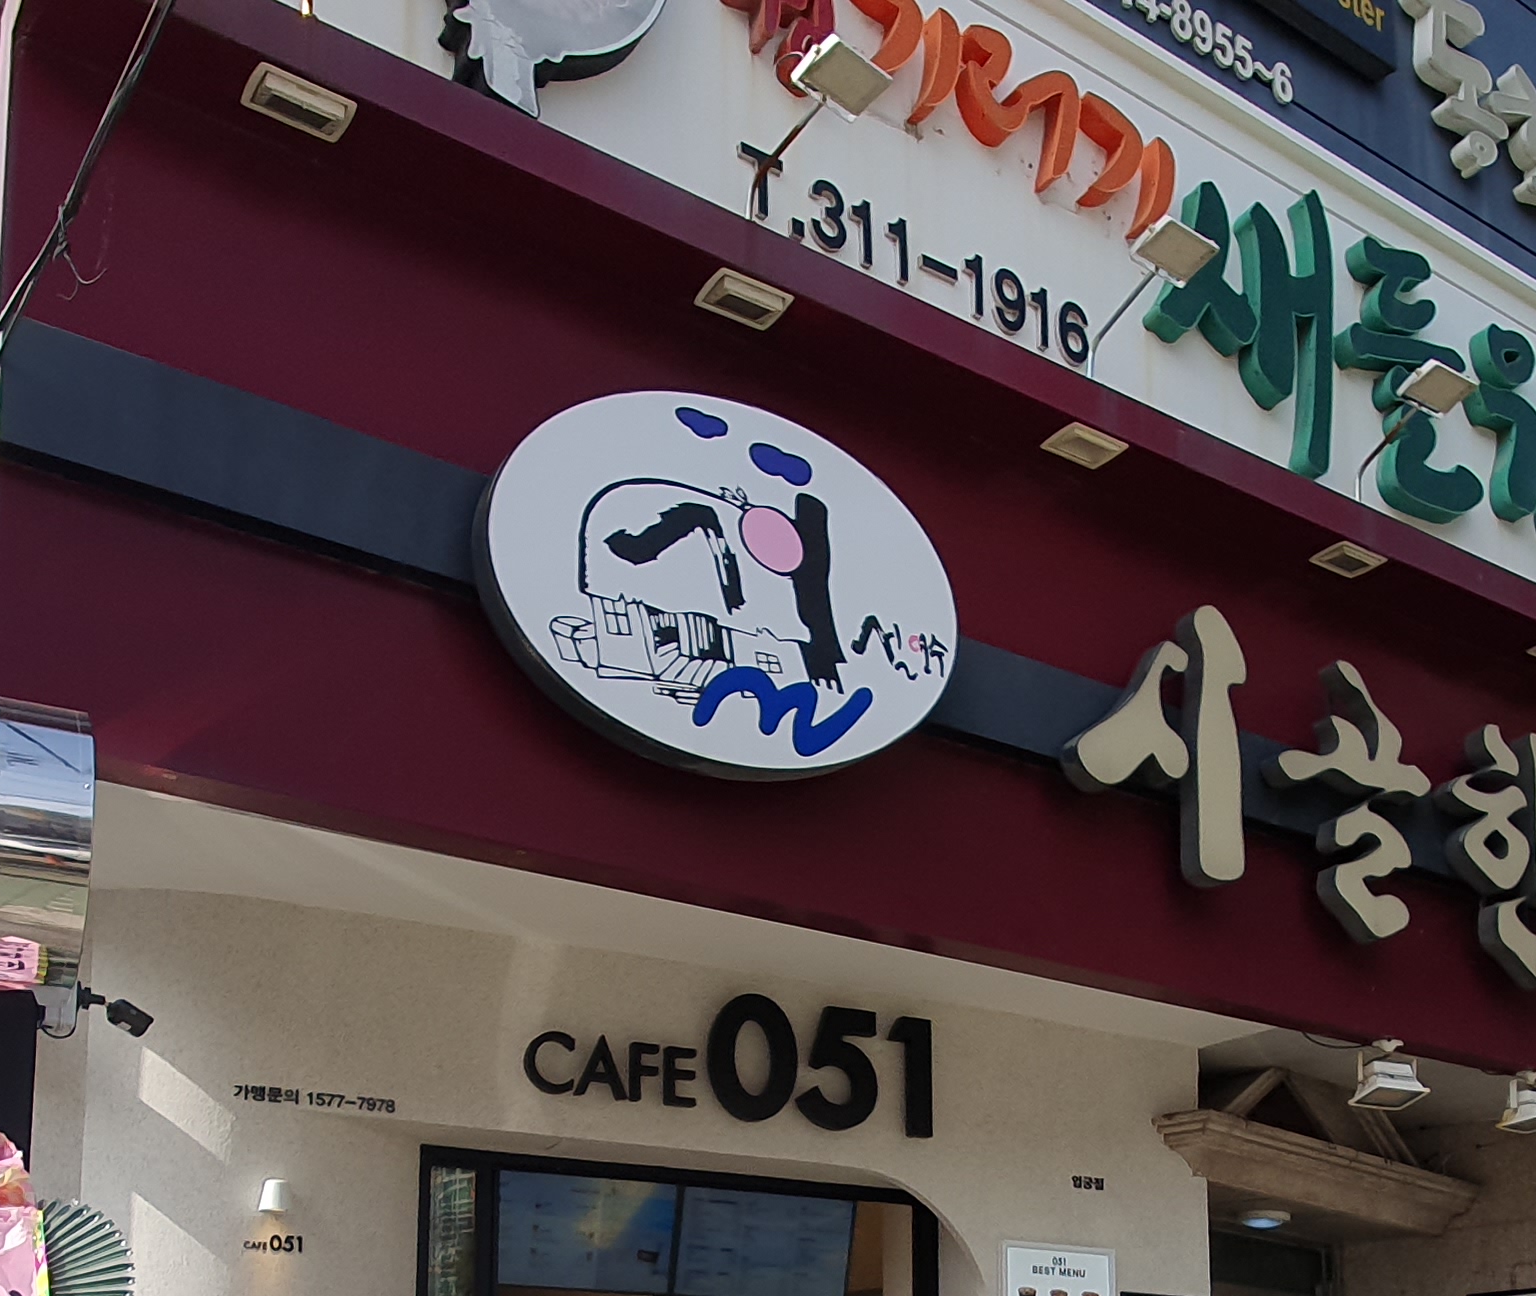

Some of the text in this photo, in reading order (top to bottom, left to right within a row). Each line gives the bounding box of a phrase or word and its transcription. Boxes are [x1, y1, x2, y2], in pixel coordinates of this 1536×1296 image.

[1121, 0, 1295, 106] 4-8955~6
[522, 992, 934, 1139] CAFE 051
[233, 1084, 396, 1113] 가맹문의 1577-7978
[268, 1233, 304, 1253] 051
[1031, 1265, 1086, 1278] BEST MENU
